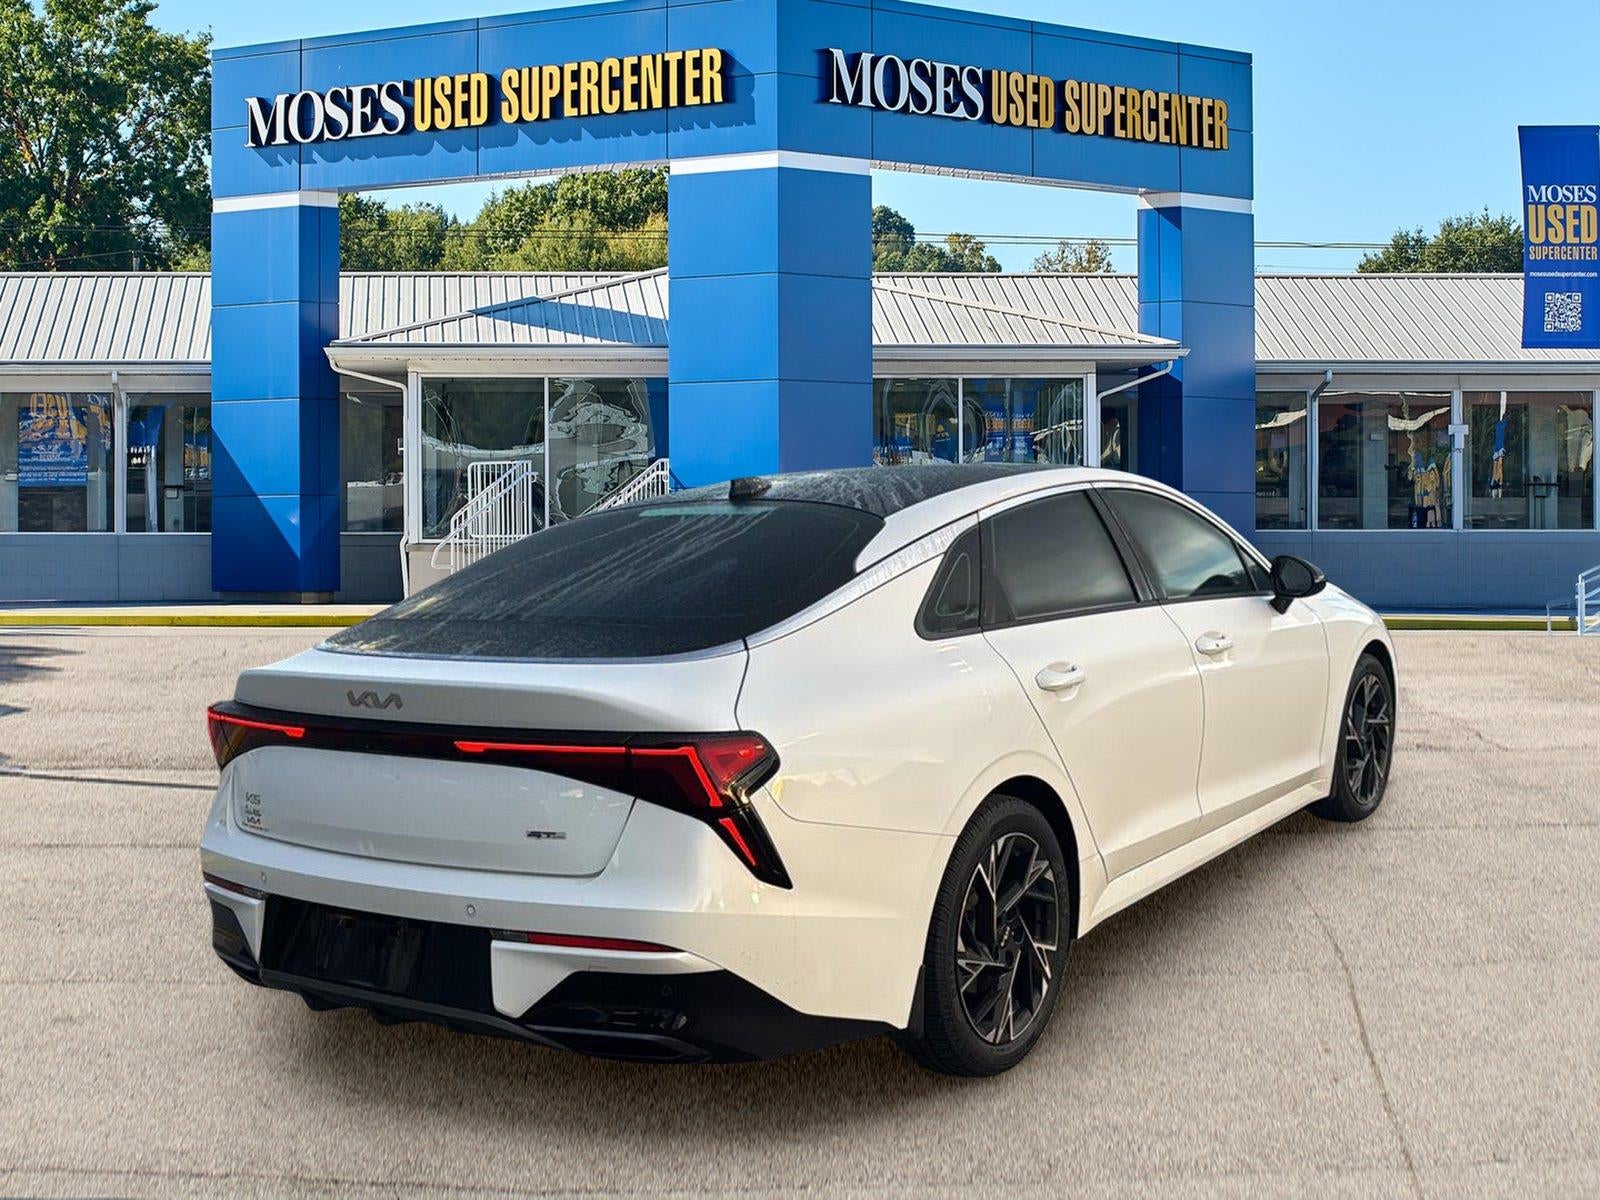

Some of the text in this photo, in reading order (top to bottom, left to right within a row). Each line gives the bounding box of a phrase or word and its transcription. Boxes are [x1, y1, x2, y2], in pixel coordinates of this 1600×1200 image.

[244, 48, 724, 148] MOSES USED SUPERCENTER
[829, 48, 1230, 150] MOSES USED SUPERCENTER
[1527, 184, 1597, 203] MOSES
[1528, 204, 1598, 244] USED
[1529, 246, 1598, 260] SUPERCENTER
[346, 689, 403, 710] KIA
